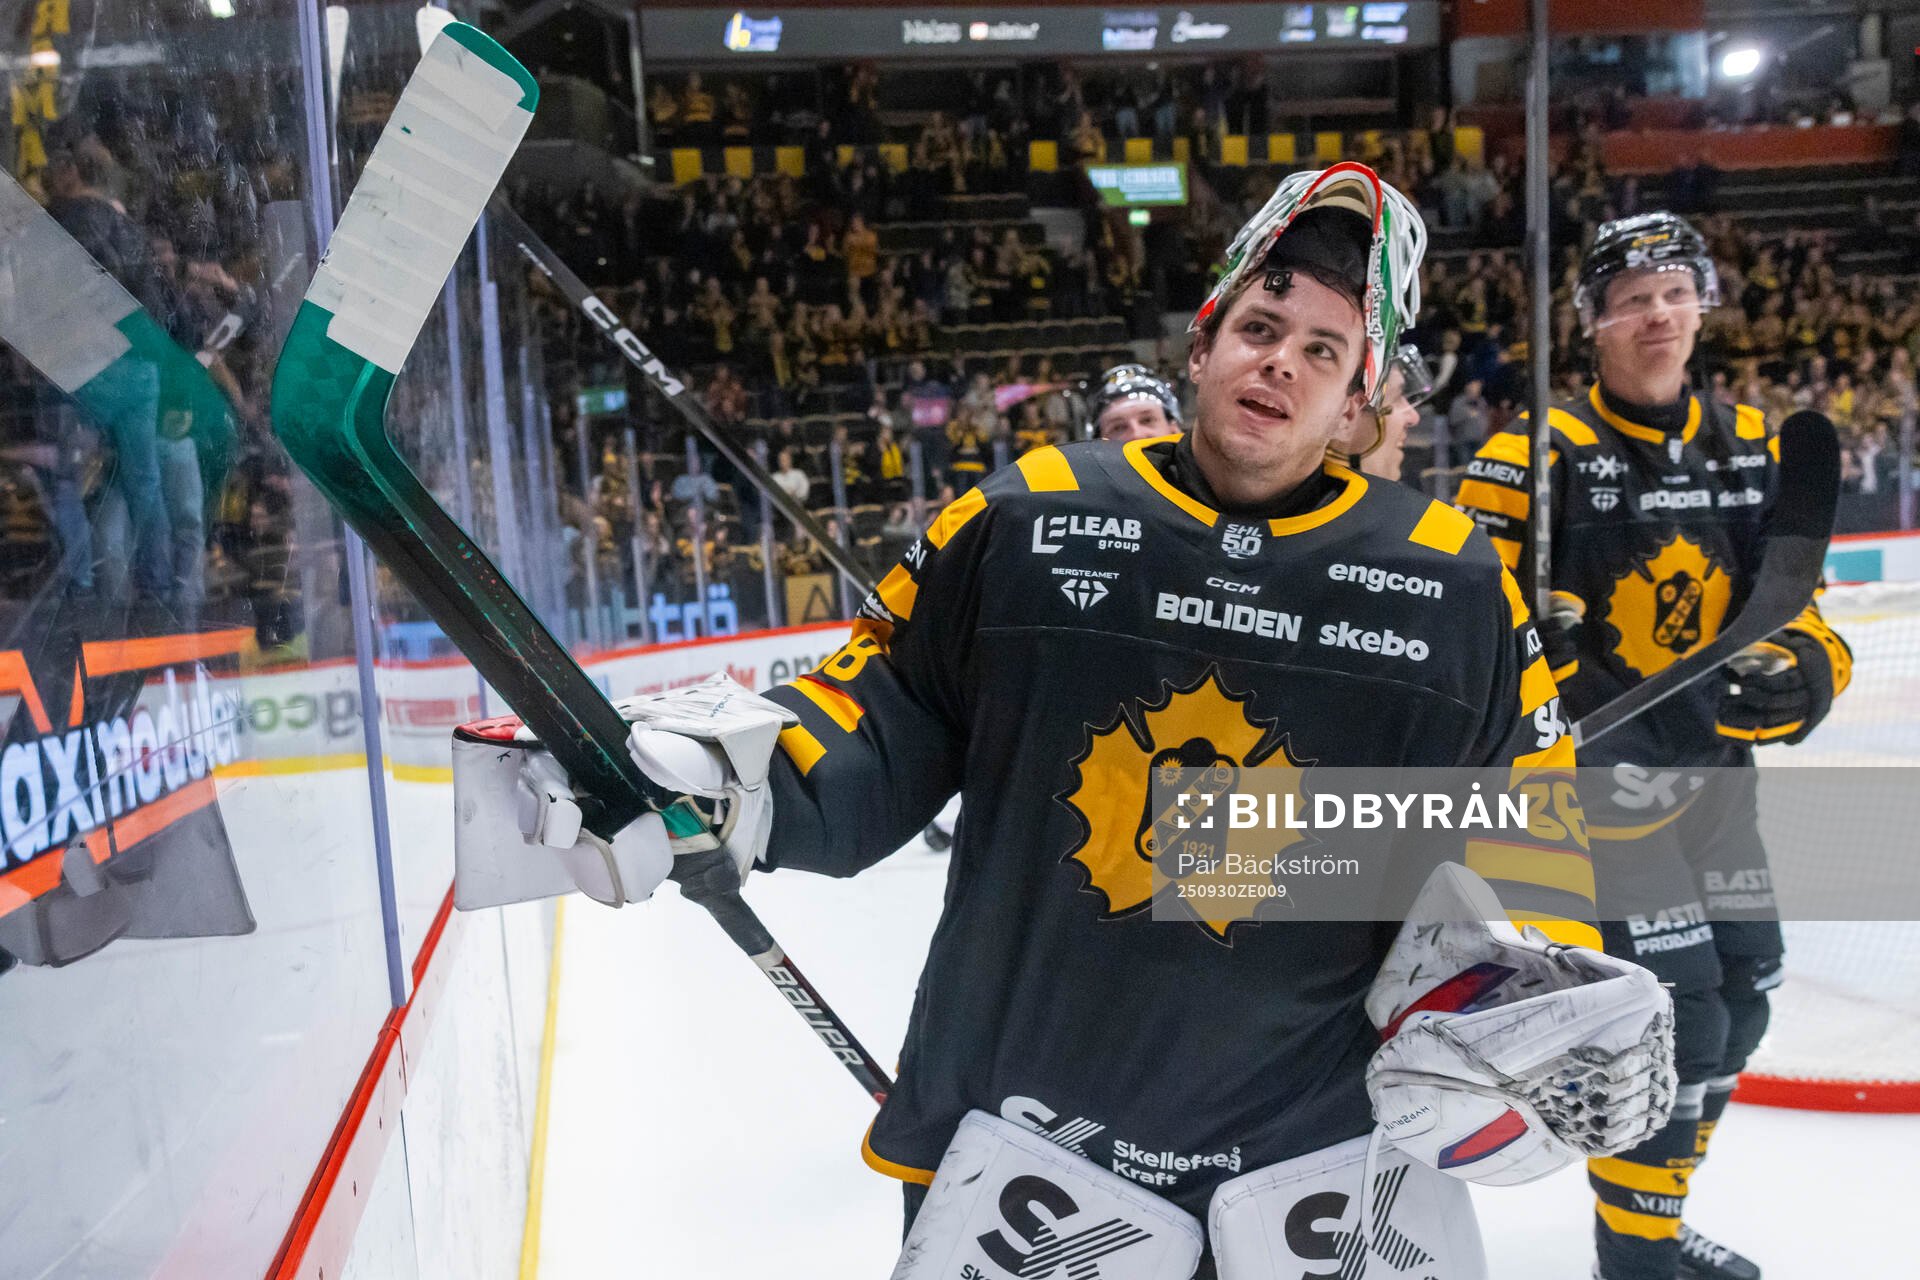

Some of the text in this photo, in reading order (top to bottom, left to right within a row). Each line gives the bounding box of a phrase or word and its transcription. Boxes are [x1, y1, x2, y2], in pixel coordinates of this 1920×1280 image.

[582, 296, 685, 396] CCM
[1069, 515, 1142, 540] LEAB
[1225, 523, 1263, 537] SHL
[1098, 539, 1140, 553] group
[1221, 532, 1262, 557] 50
[1051, 567, 1120, 580] BERGTEAMET
[1206, 577, 1261, 595] CCM
[1328, 563, 1443, 599] engcon
[1155, 592, 1302, 643] BOLIDEN
[1319, 621, 1430, 662] skebo
[766, 966, 865, 1066] BAUER
[1113, 1139, 1242, 1173] Skellefteå
[1113, 1158, 1178, 1186] Kraft
